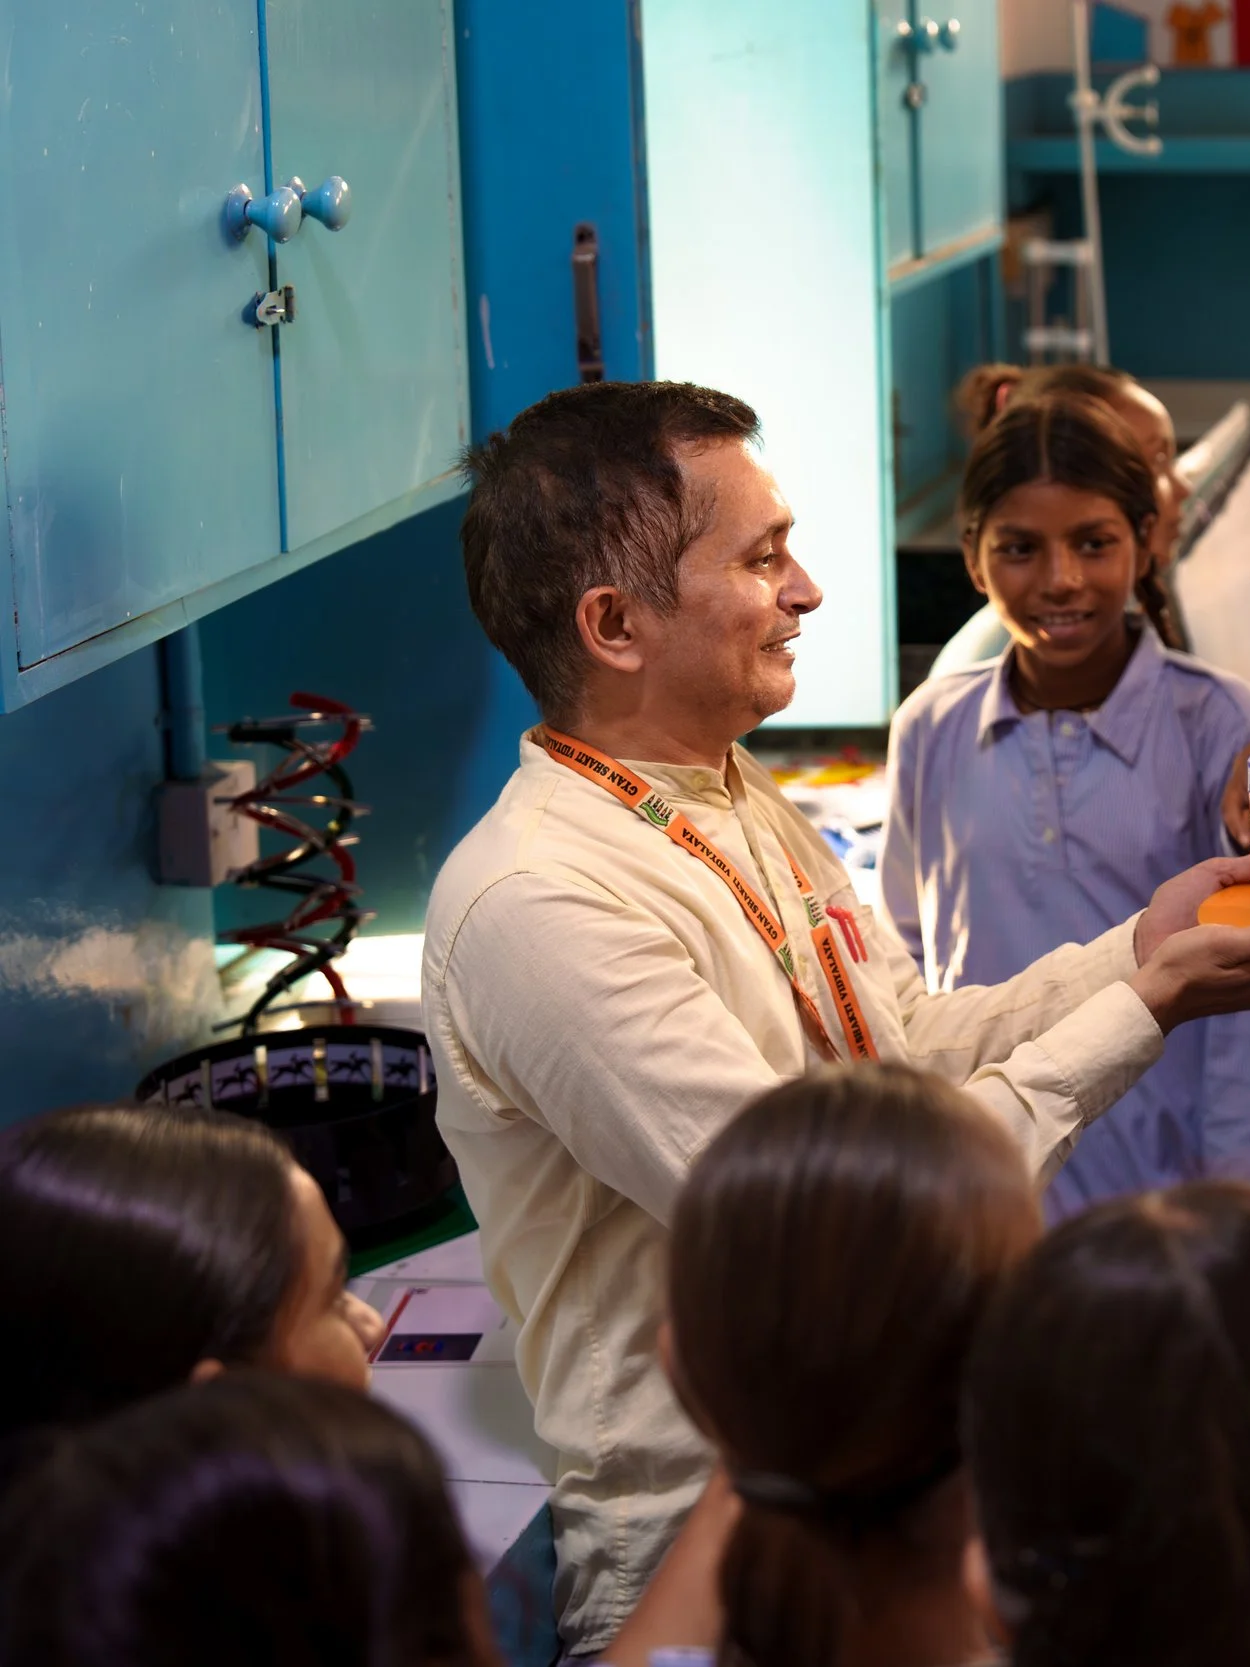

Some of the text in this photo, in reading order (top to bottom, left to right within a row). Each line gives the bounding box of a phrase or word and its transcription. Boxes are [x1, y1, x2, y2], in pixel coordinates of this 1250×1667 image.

[574, 751, 610, 777] SHAKTI
[607, 771, 638, 796] GYAN
[681, 828, 778, 940] GYAN SHAKTI VIDYALAYA
[822, 937, 848, 1001] VIDYALAYA
[843, 1002, 865, 1043] SHAKTI
